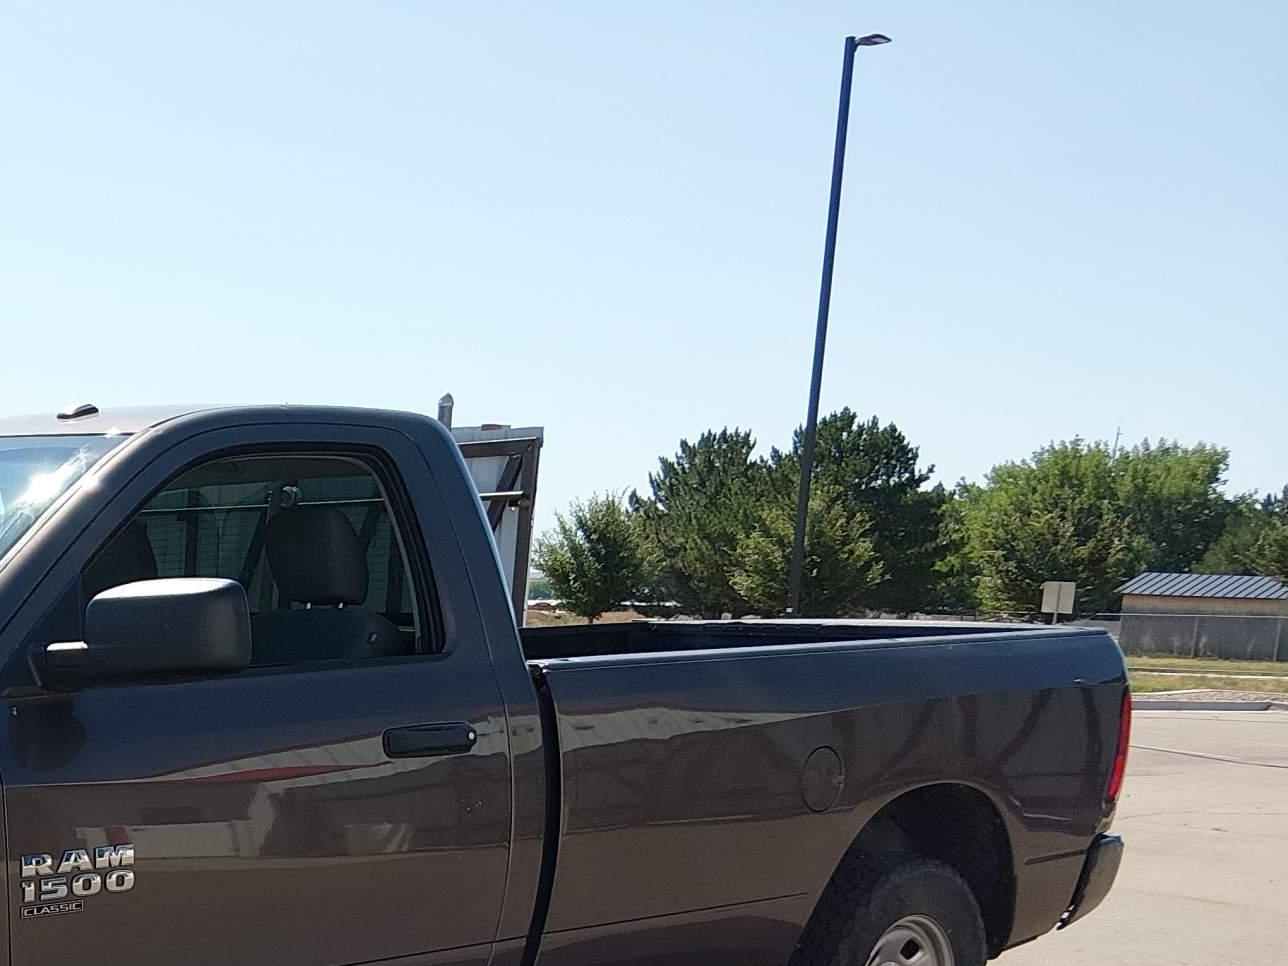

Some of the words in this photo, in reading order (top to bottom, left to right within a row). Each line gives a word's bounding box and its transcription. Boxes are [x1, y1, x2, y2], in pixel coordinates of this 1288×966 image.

[21, 844, 135, 877] RAM
[21, 869, 135, 903] 1500
[23, 903, 82, 917] CLASSIC
